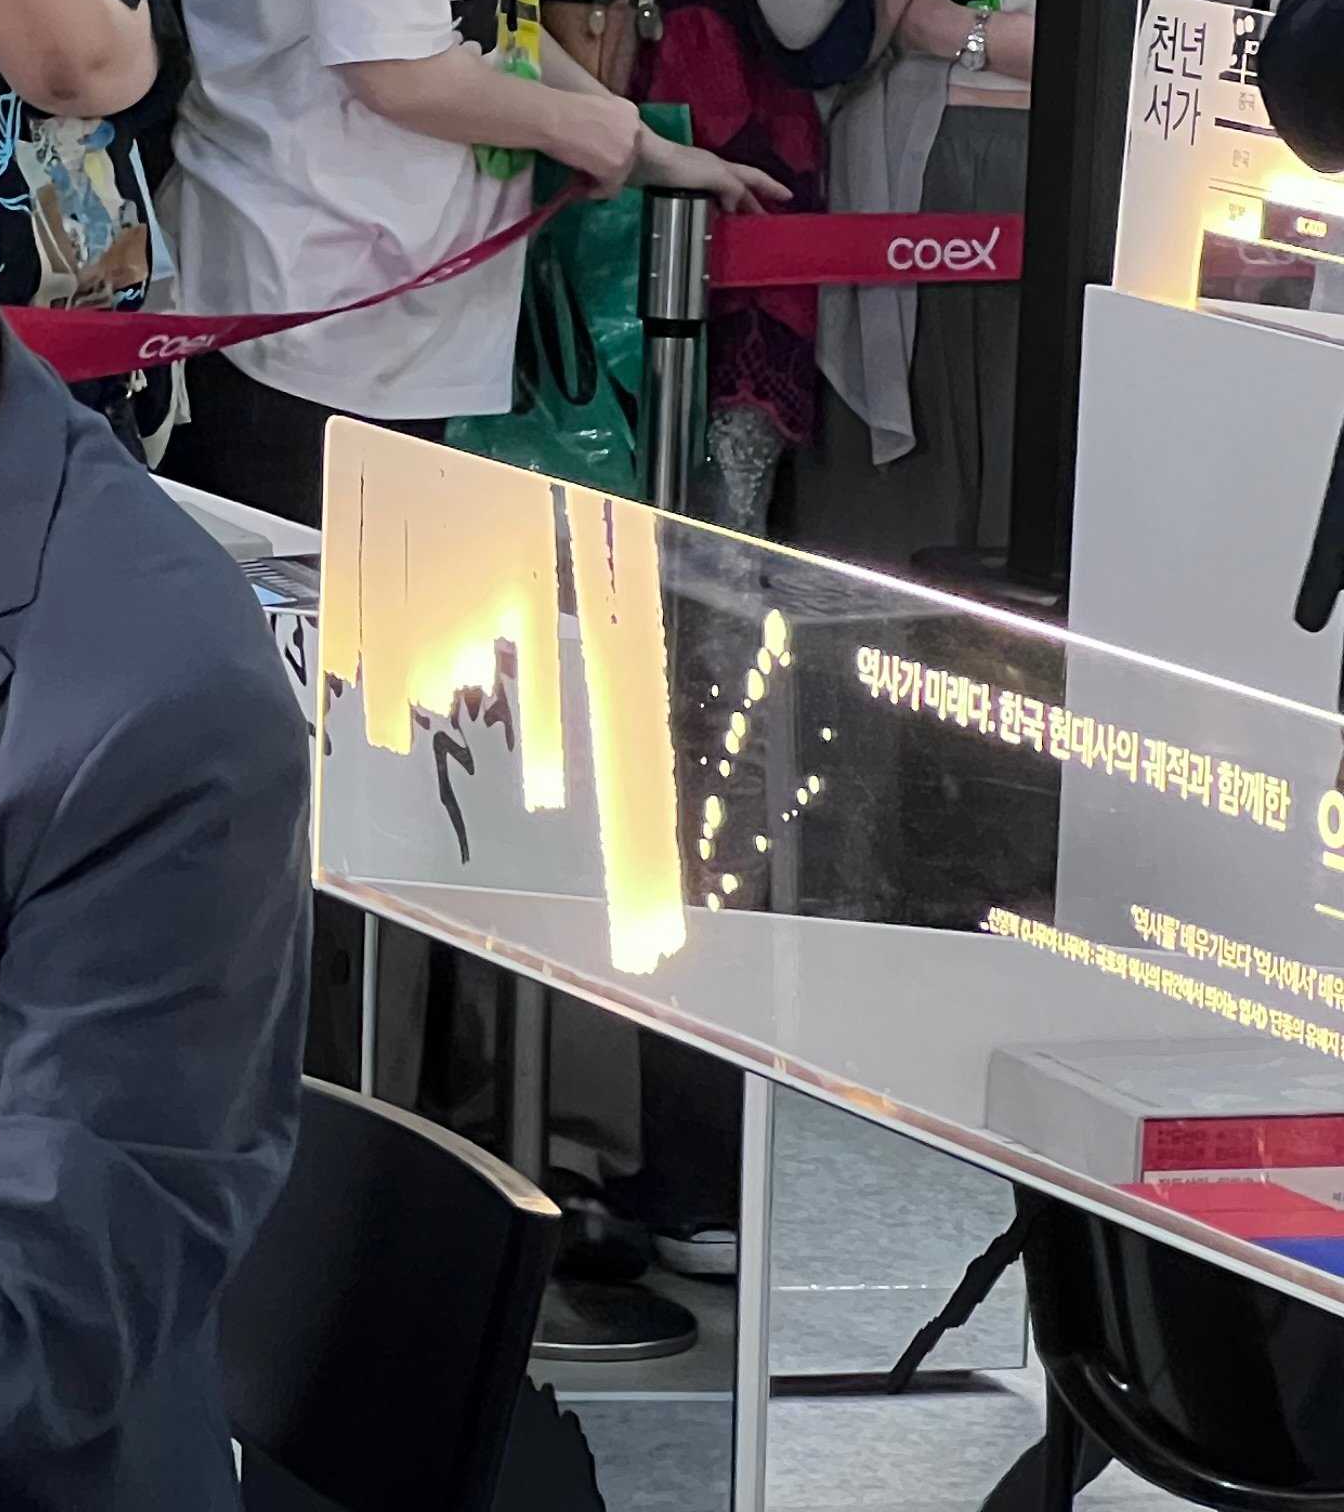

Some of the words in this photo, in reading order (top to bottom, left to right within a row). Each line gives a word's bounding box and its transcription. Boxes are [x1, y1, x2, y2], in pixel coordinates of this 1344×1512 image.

[1149, 15, 1207, 80] 천년
[1144, 82, 1201, 146] 서가
[887, 227, 1001, 271] coex
[857, 646, 922, 712] 역사가
[925, 668, 996, 734] 미래다.
[998, 690, 1045, 752] 한국
[1048, 706, 1139, 783] 현대사의
[1142, 738, 1213, 807] 궤적과
[1217, 760, 1290, 832] 함께한
[1057, 932, 1090, 965] 나무야
[1129, 957, 1160, 991] 역사의
[1180, 924, 1252, 978] 배우기보다
